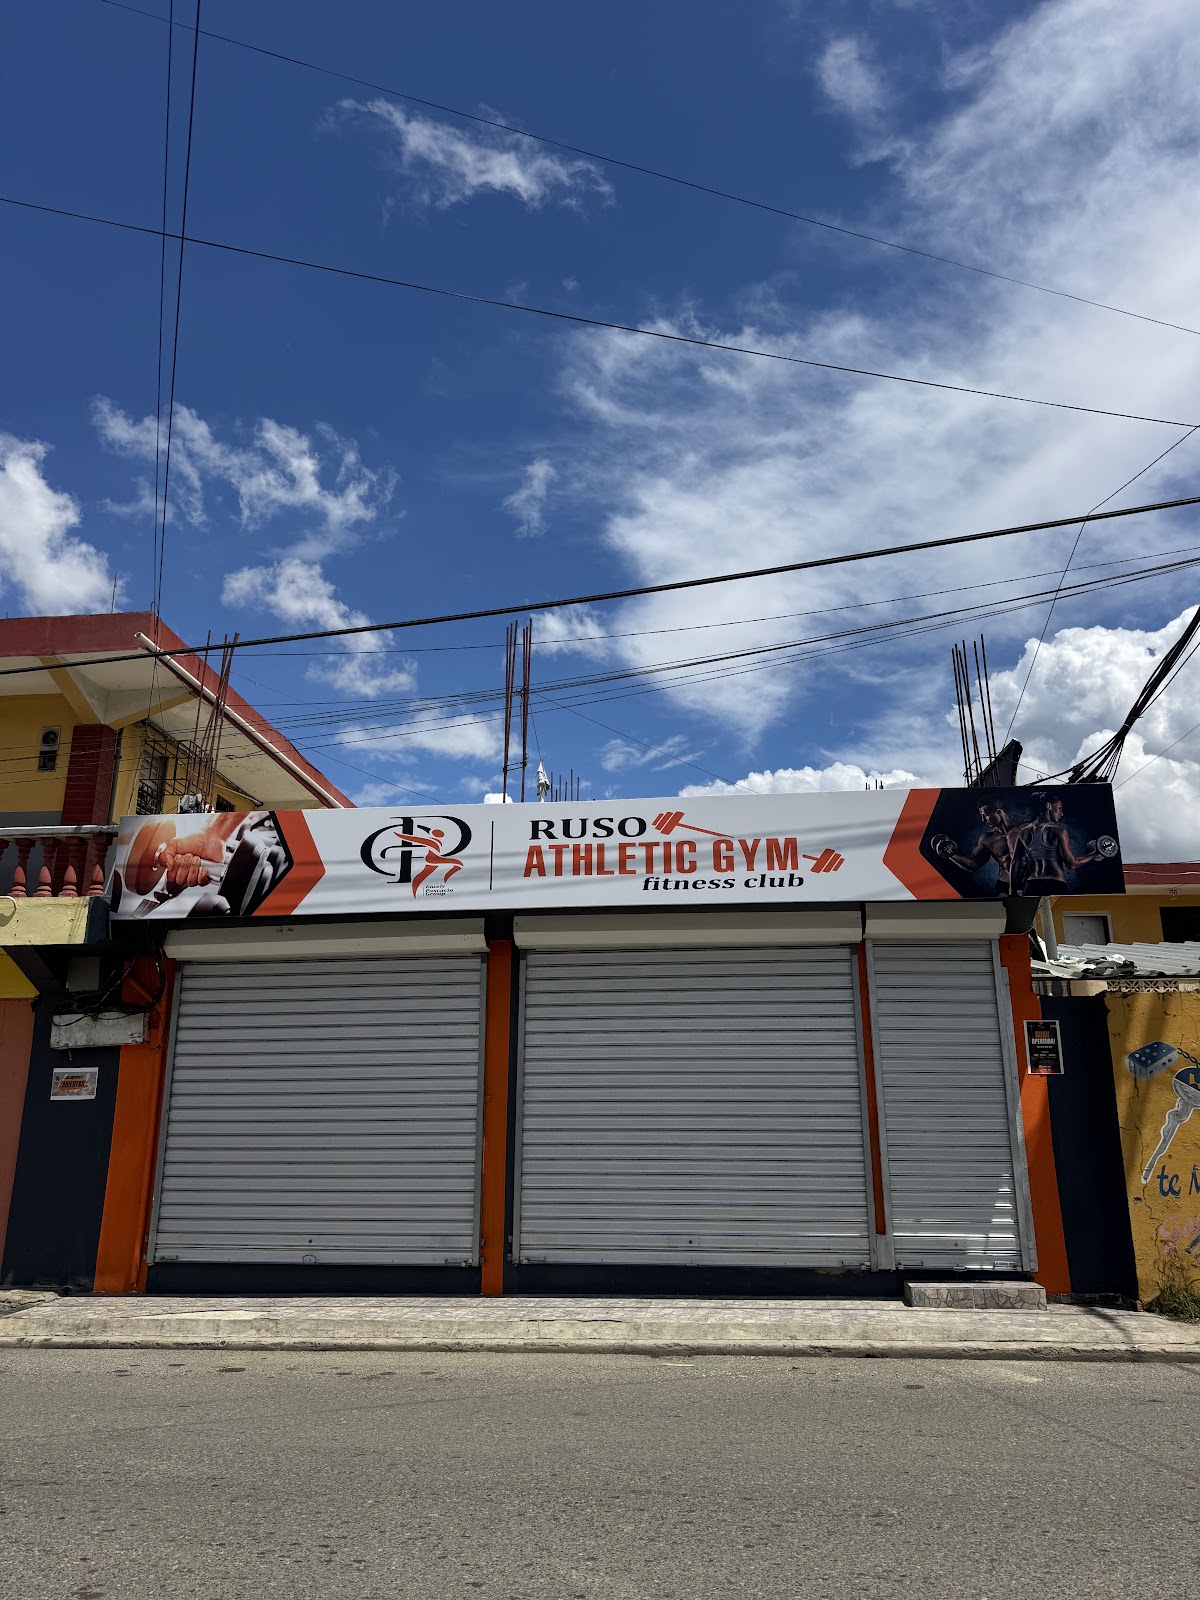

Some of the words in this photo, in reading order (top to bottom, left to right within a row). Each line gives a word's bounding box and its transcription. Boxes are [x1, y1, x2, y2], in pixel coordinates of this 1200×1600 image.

[528, 816, 647, 840] RUSO
[523, 840, 697, 877] ATHLETIC
[712, 837, 799, 873] GYM
[642, 876, 736, 891] fitness
[743, 873, 804, 889] club
[1156, 1164, 1182, 1197] te
